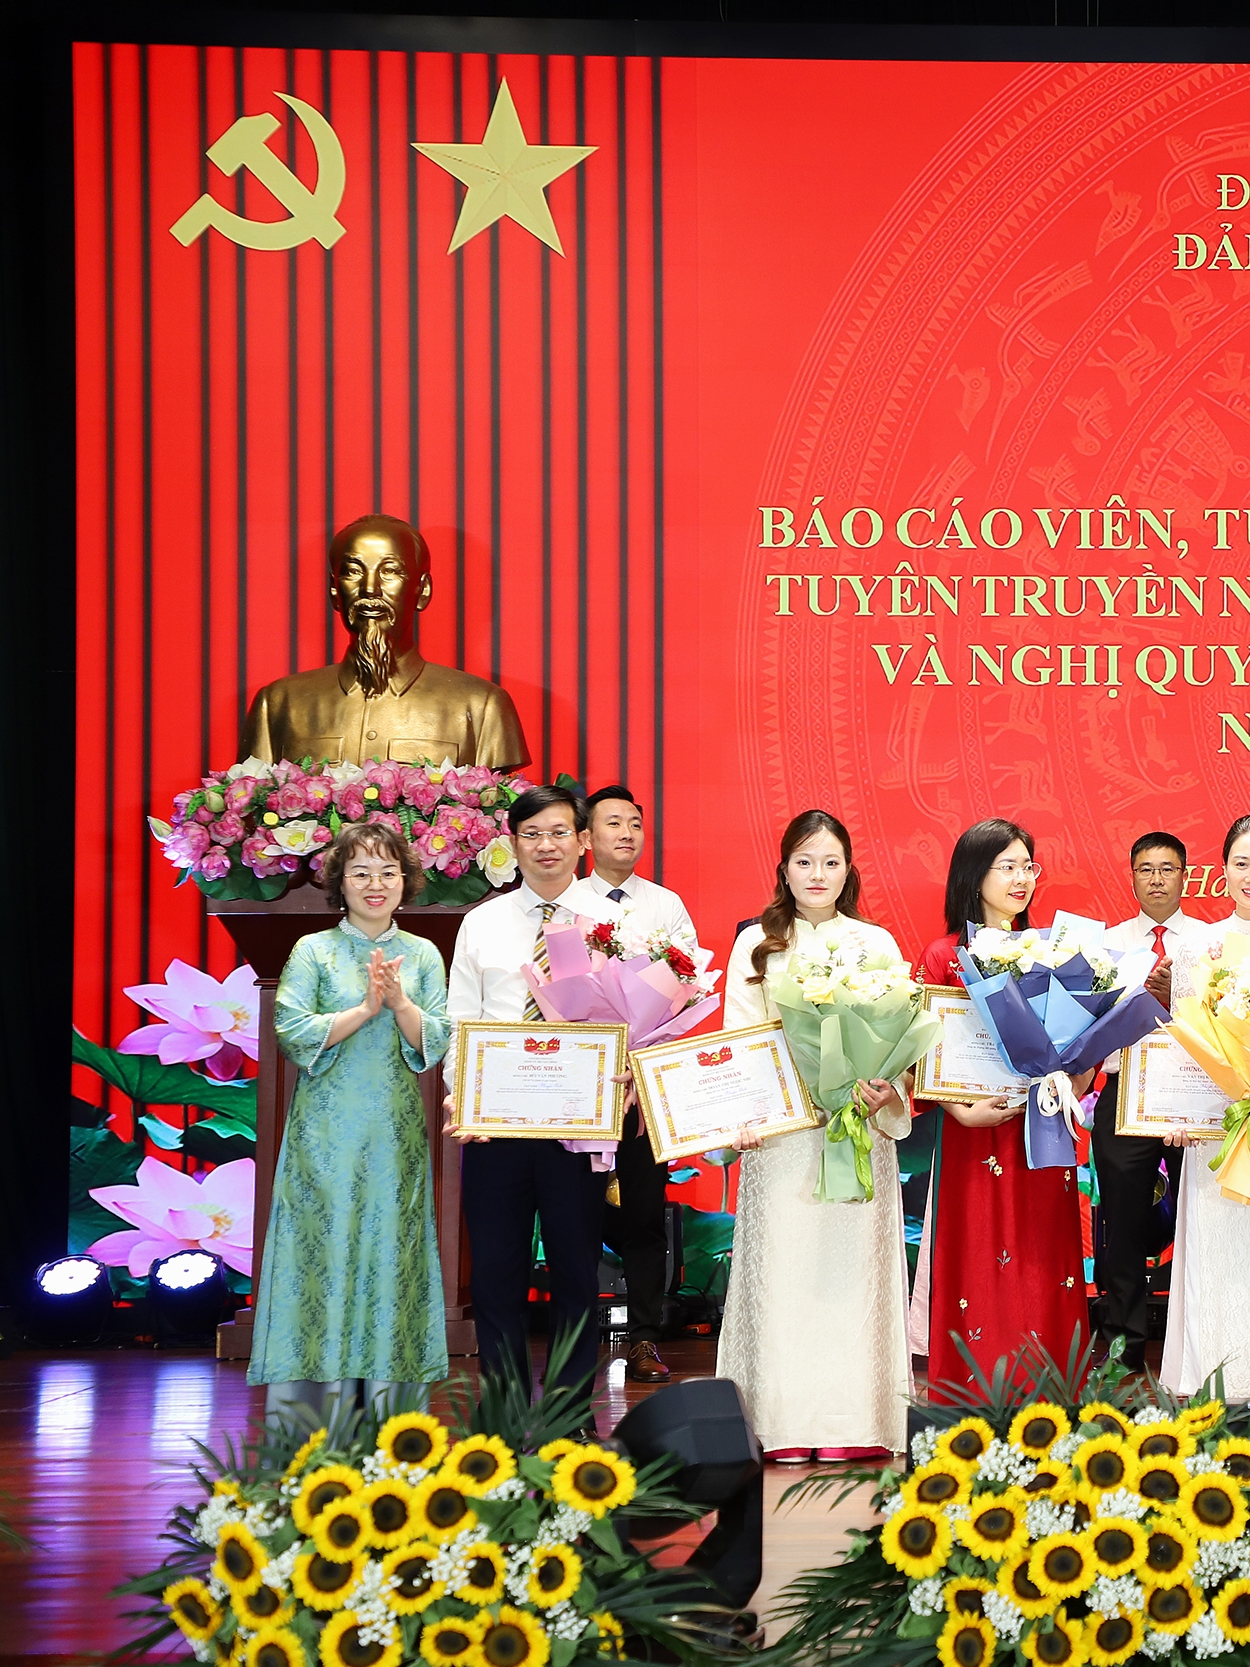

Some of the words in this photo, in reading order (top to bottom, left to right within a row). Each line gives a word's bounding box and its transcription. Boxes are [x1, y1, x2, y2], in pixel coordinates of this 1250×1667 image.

[758, 496, 884, 548] BÁO
[896, 497, 1023, 549] CÁO
[1032, 494, 1189, 559] VIÊN,
[766, 562, 963, 616] TUYÊN
[972, 562, 1208, 617] TRUYỀN
[871, 633, 953, 686] VÀ
[967, 644, 1123, 699] NGHỊ
